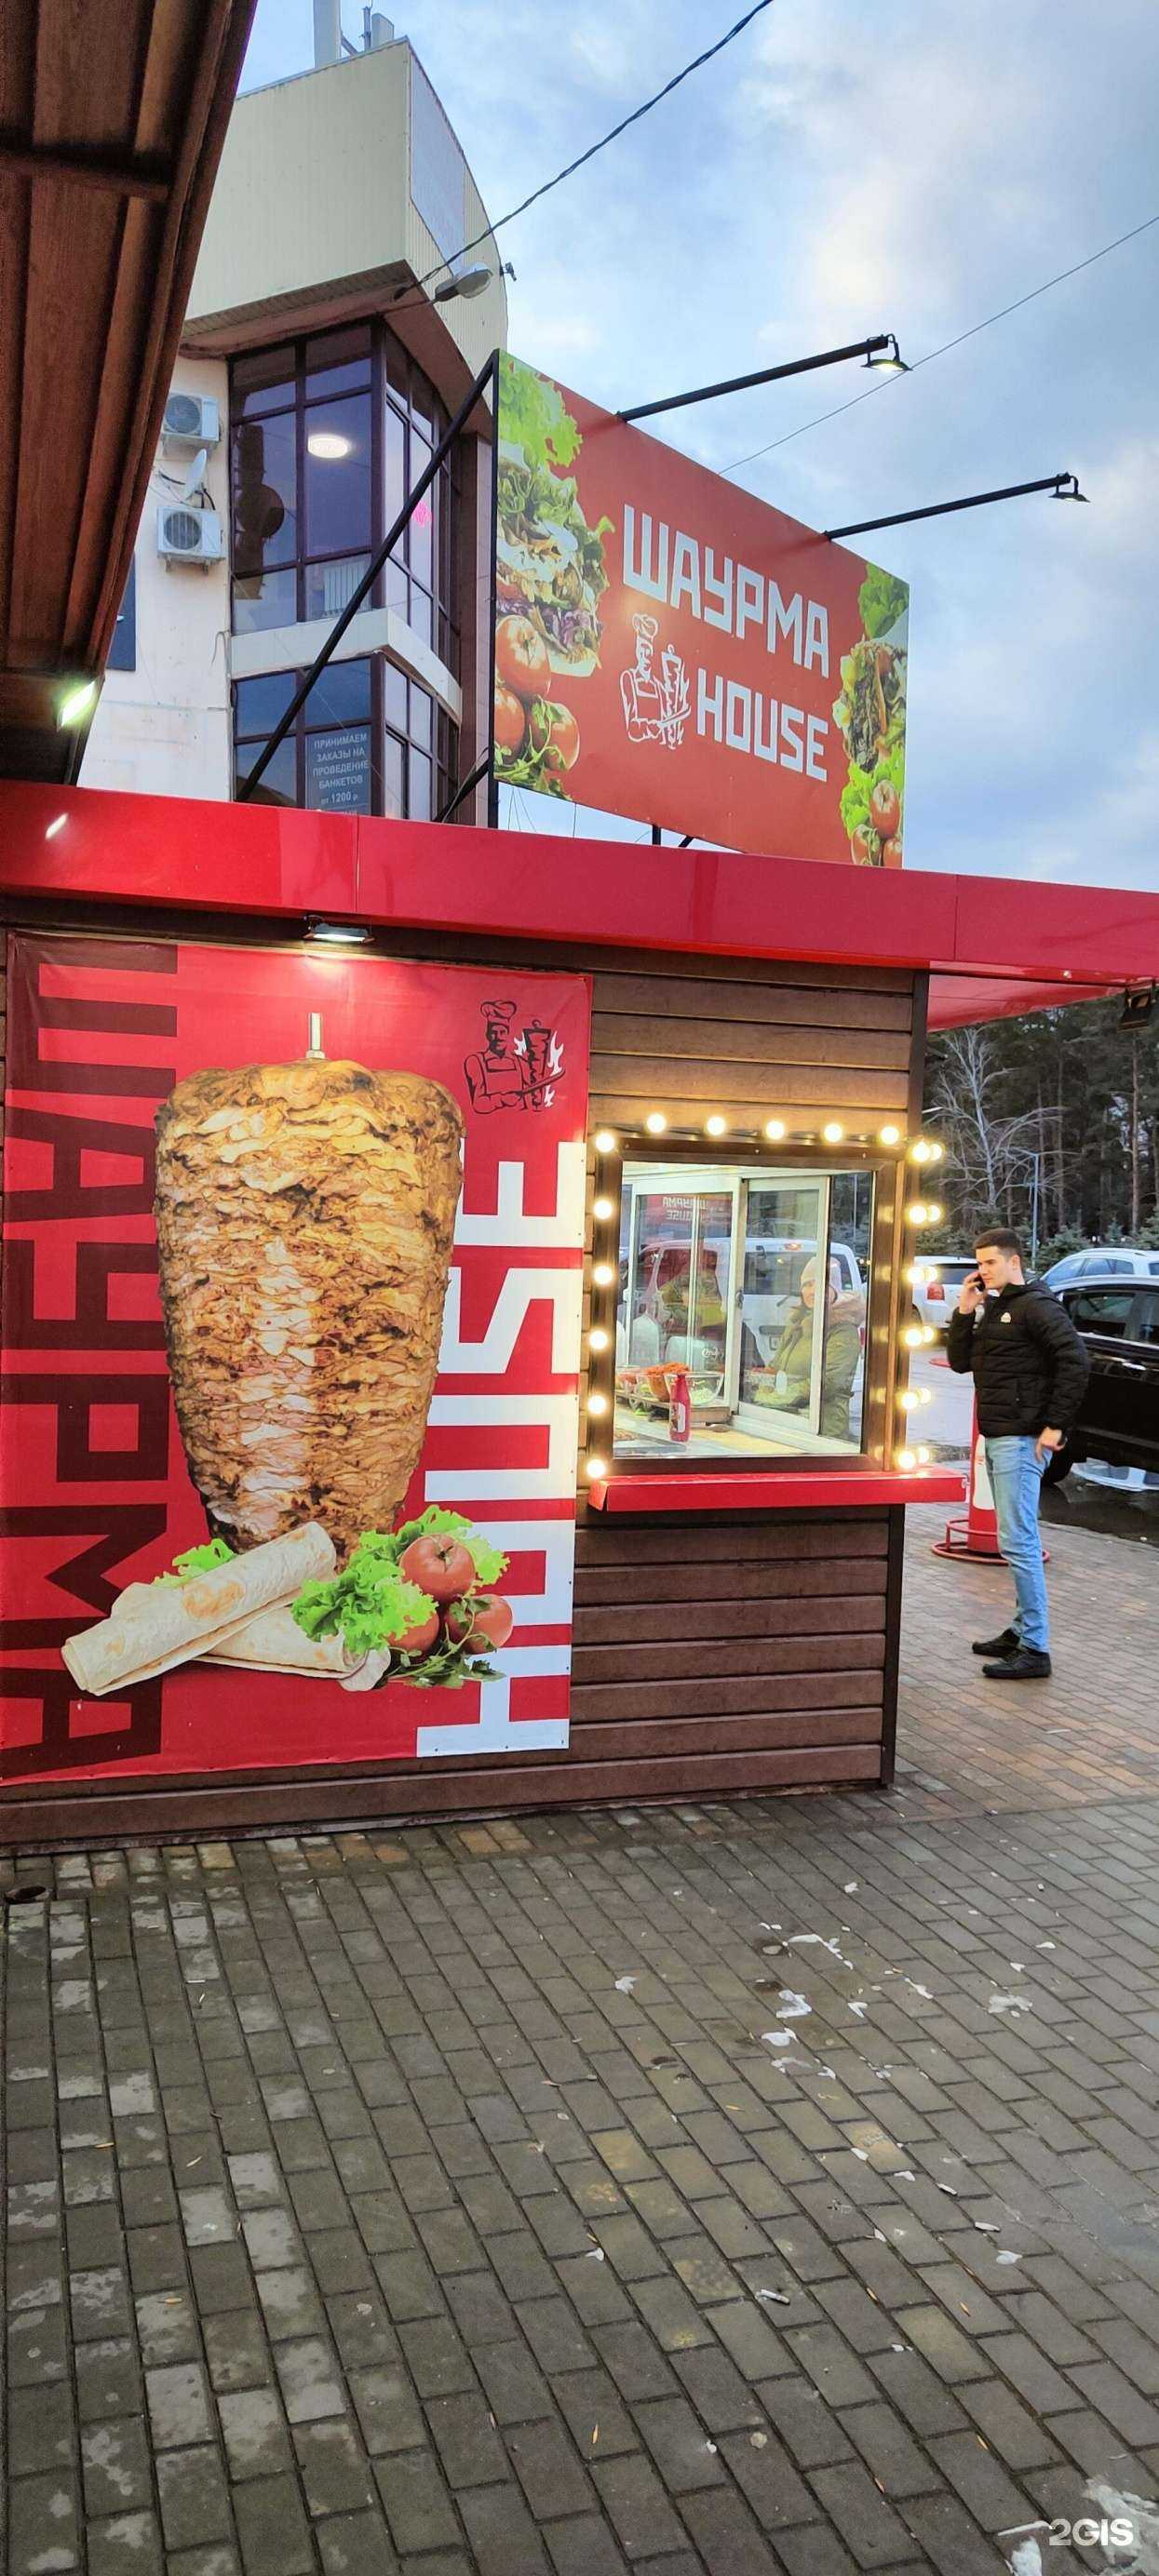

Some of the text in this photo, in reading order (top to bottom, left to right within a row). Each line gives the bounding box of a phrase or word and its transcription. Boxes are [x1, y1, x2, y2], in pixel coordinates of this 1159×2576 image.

[623, 503, 829, 678] ШАУРМА
[697, 667, 829, 783] HOUSE
[314, 732, 367, 749] ПРИНИМАЕМ
[317, 747, 365, 762] ЗАКАЗЫ НА
[313, 759, 370, 778] ПРОВЕДЕНИЕ
[318, 774, 363, 789] БАНКЕТОВ
[331, 791, 352, 803] 1200
[2, 932, 178, 1785] ШАУРМА
[416, 1140, 586, 1758] HOUSE
